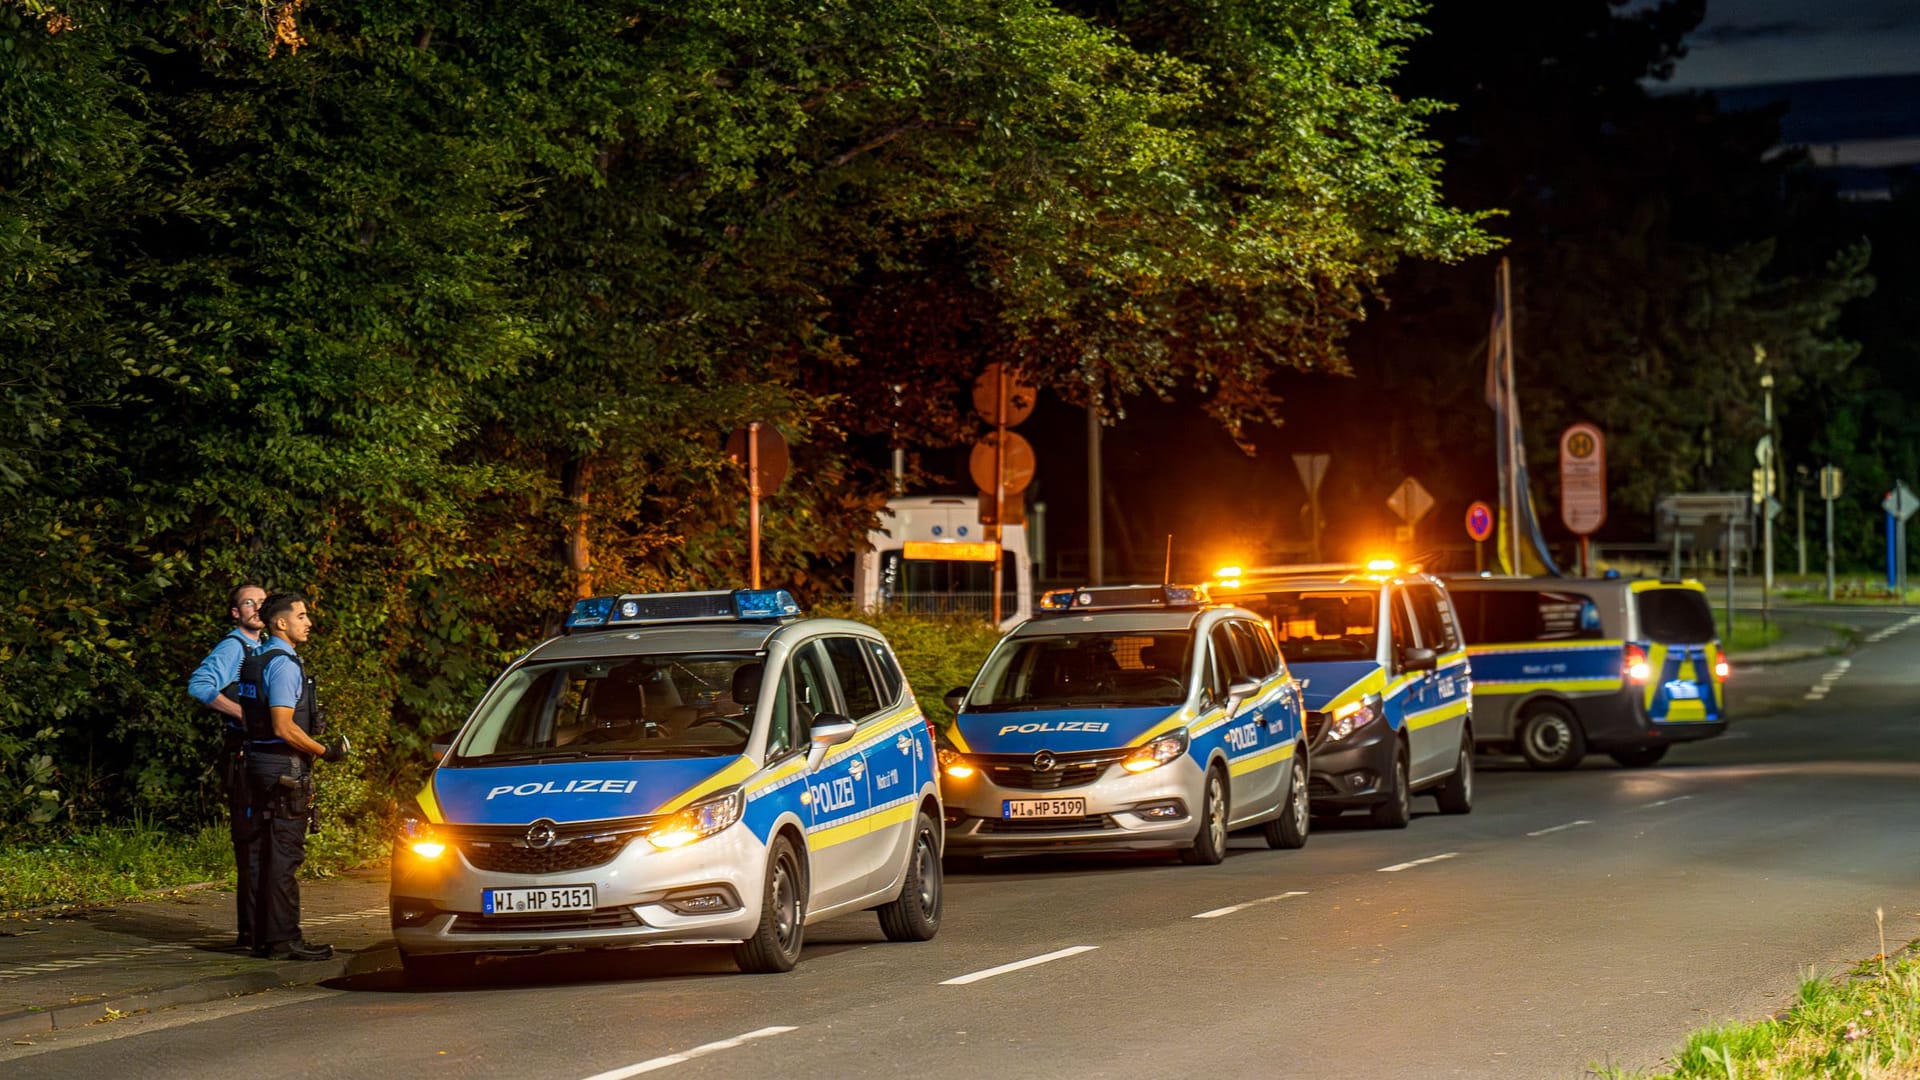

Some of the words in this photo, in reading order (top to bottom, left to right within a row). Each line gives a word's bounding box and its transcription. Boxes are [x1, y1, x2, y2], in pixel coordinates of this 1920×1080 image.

[998, 722, 1109, 736] POLIZEI
[486, 780, 638, 800] POLIZEI
[810, 776, 855, 815] POLIZEI
[1011, 803, 1026, 816] WI
[1035, 802, 1050, 815] HP
[1053, 801, 1082, 815] 5199
[495, 892, 513, 910] WI
[527, 891, 547, 909] HP
[552, 889, 591, 908] 5151
